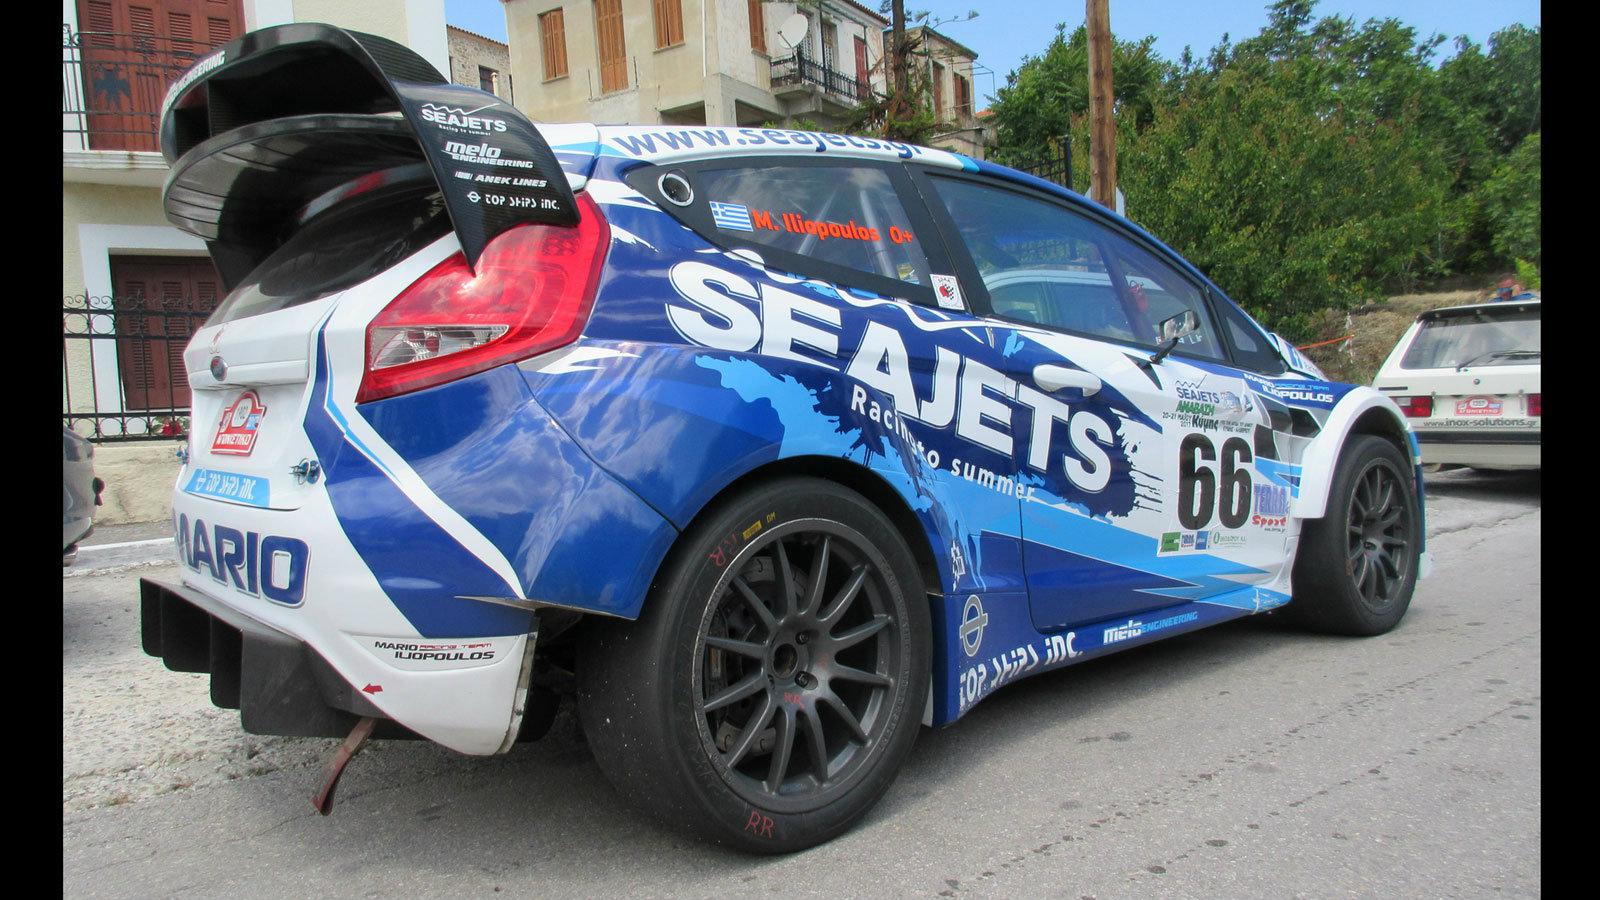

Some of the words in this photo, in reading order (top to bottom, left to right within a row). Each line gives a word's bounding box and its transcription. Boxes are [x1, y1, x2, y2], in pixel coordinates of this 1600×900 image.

[421, 108, 507, 132] SEAJETS
[445, 141, 501, 159] melo
[451, 153, 534, 169] ENGINEERING
[475, 174, 512, 185] ANEK
[512, 178, 548, 188] LINES
[751, 208, 781, 232] M.
[782, 212, 881, 241] Iliopoulos
[665, 260, 1114, 494] SEAJETS
[1176, 387, 1220, 404] SEAJETS
[1423, 417, 1537, 429] www.inox-solutions.gr
[851, 384, 918, 456] Racing
[951, 458, 1035, 502] summer
[1178, 432, 1252, 530] 66
[174, 512, 310, 608] MARIO
[1103, 621, 1142, 645] melo
[1141, 611, 1198, 633] ENGINEERING
[374, 641, 418, 651] MARIO
[394, 650, 496, 661] ILIOPOULOS
